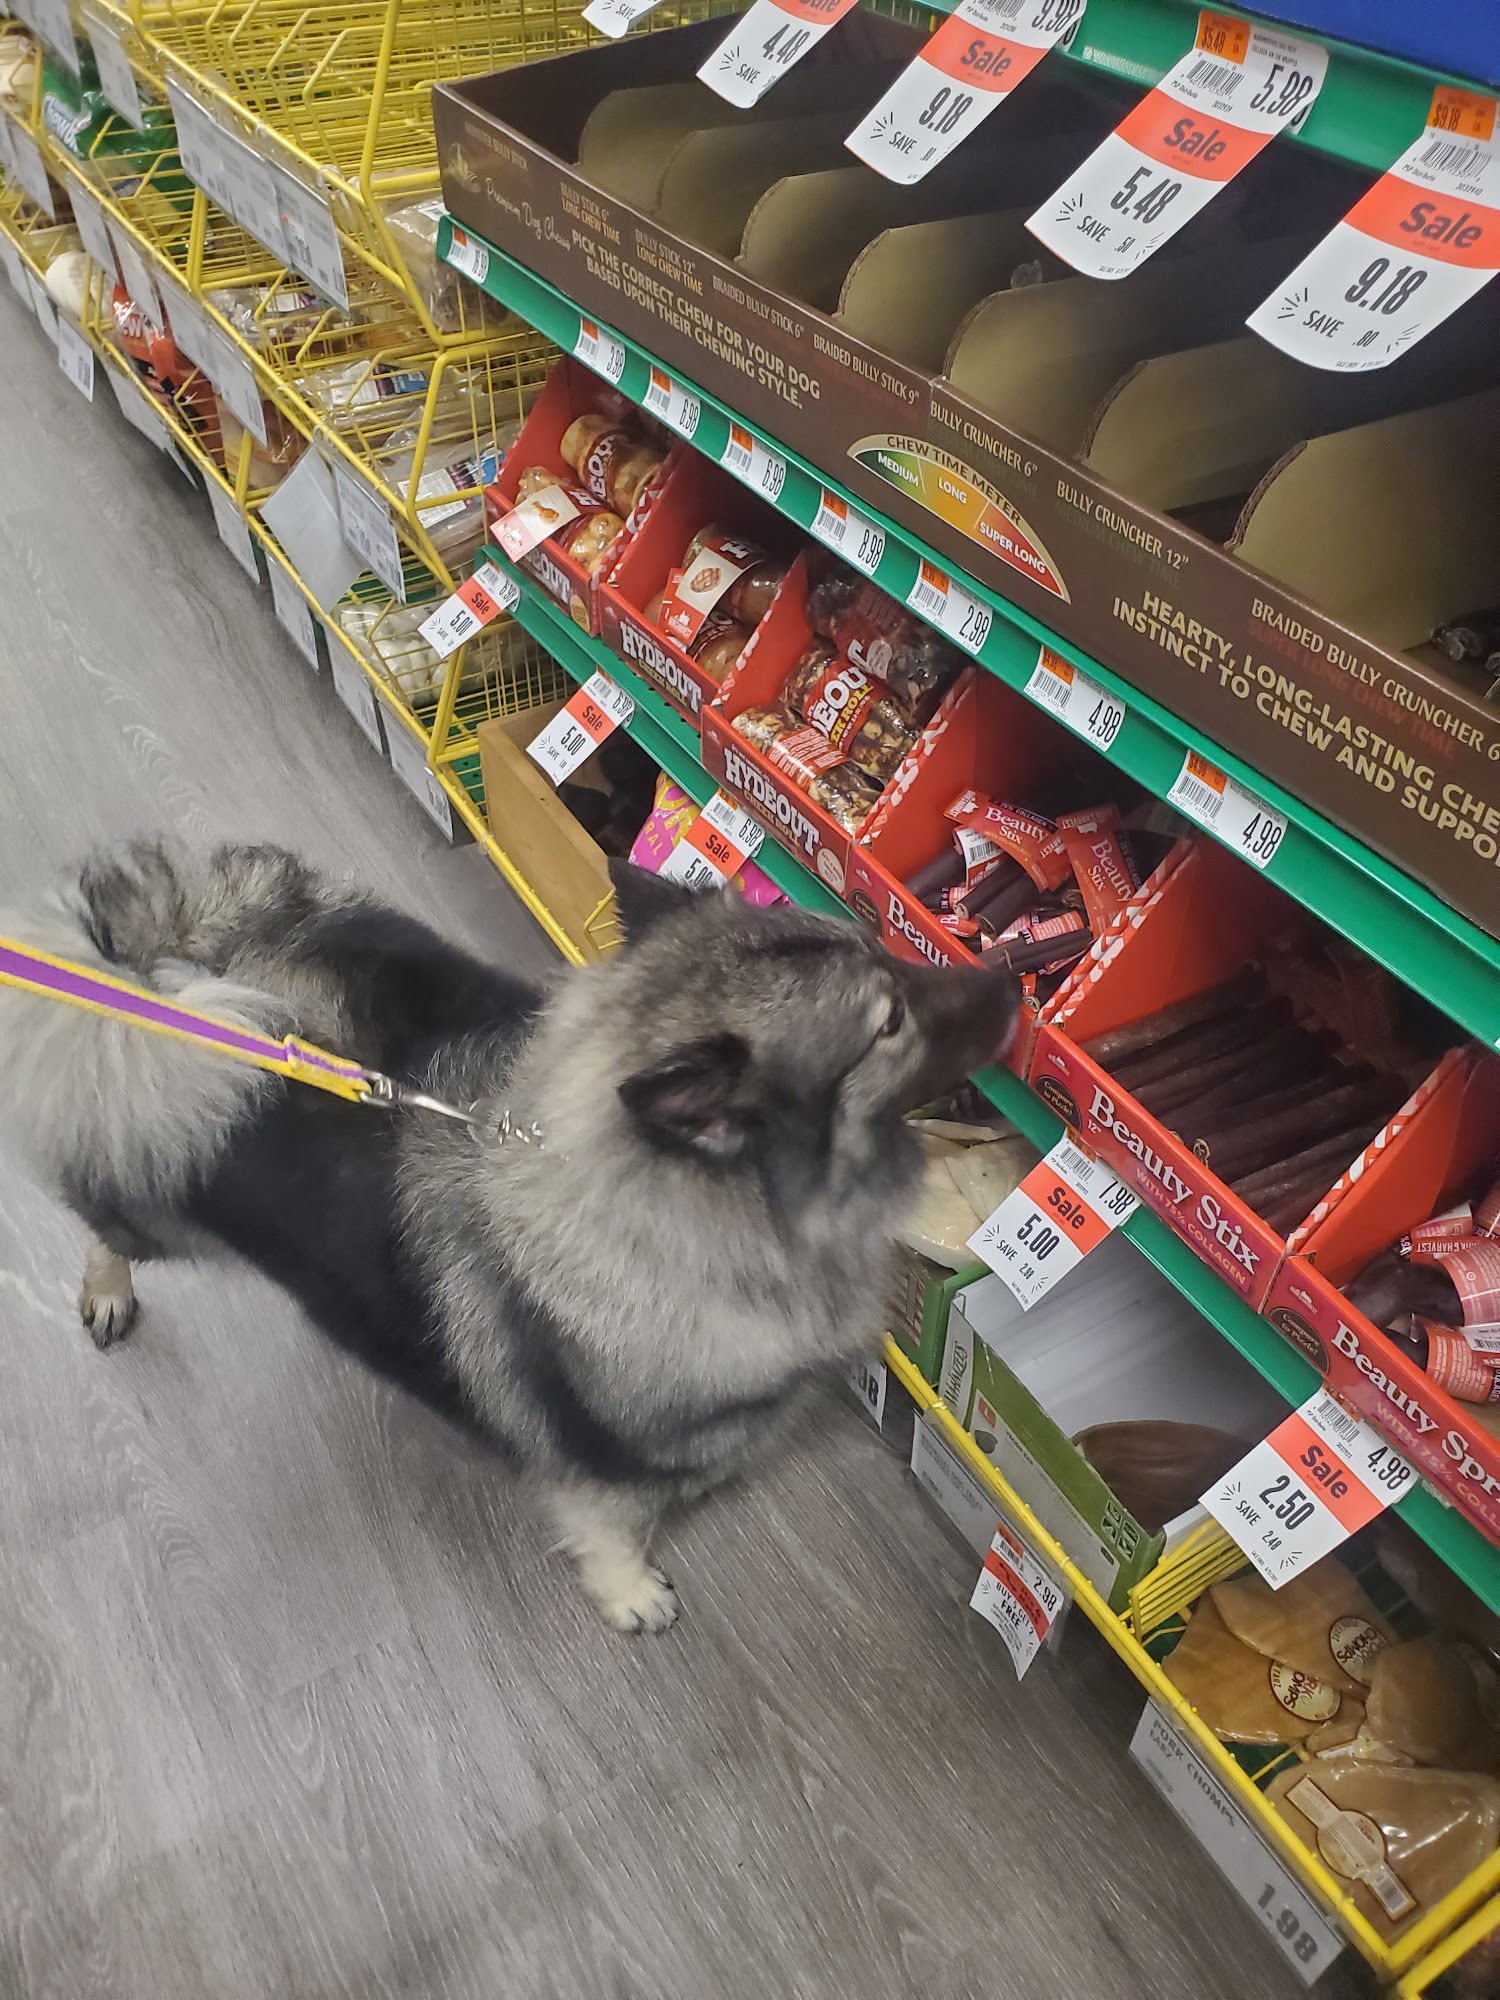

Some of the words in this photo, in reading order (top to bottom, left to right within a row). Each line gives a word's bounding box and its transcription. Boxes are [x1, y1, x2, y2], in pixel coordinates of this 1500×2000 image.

[615, 3, 637, 20] SAVE
[762, 23, 811, 65] 4.48
[960, 39, 1012, 77] Sale
[1202, 25, 1226, 54] $5.48
[735, 63, 761, 85] SAVE
[1249, 63, 1313, 117] 5.98
[918, 86, 974, 134] 9.18
[889, 131, 917, 155] SAVE
[1163, 118, 1226, 162] Sale
[1110, 166, 1183, 224] 5.48
[561, 200, 580, 221] LONG
[580, 211, 601, 233] CHEW
[600, 222, 620, 246] TIME
[1076, 215, 1111, 243] SAVE
[1114, 236, 1136, 253] .50
[1398, 202, 1483, 249] Sale
[636, 244, 657, 268] LONG
[657, 257, 682, 283] CHEW
[682, 272, 704, 296] TIME
[657, 240, 682, 267] STICK
[712, 275, 745, 305] BRAIDED
[745, 294, 770, 319] BULLY
[770, 309, 795, 335] STICK
[1344, 257, 1428, 315] 9.18
[572, 229, 596, 255] PICK
[597, 245, 620, 268] THE
[621, 262, 675, 306] CORRECT
[676, 296, 716, 332] CHEW
[716, 320, 743, 348] FOR
[746, 338, 785, 377] YOUR
[787, 366, 822, 400] DOG
[586, 257, 621, 290] BASED
[623, 281, 656, 313] UPON
[656, 302, 693, 338] THEIR
[695, 328, 756, 378] CHEWING
[757, 367, 804, 410] STYLE.
[1302, 309, 1345, 339] SAVE
[1351, 330, 1380, 348] .80
[606, 345, 624, 378] 3.98
[813, 333, 851, 367] BRAIDED
[852, 355, 880, 383] BULLY
[880, 373, 907, 401] STICK
[679, 398, 699, 433] 6.98
[930, 400, 963, 433] BULLY
[962, 422, 1022, 472] CRUNCHER
[761, 459, 784, 496] 6.98
[877, 451, 920, 487] MEDIUM
[886, 436, 930, 456] CHEW
[932, 450, 969, 479] TIME
[970, 475, 1022, 526] METER
[937, 477, 968, 504] LONG
[1056, 479, 1094, 515] BULLY
[1094, 504, 1163, 558] CRUNCHER
[857, 528, 884, 569] 8.98
[979, 522, 1013, 553] SUPER
[1014, 547, 1047, 575] LONG
[471, 591, 489, 615] Sale
[499, 579, 518, 603] 6.98
[437, 627, 449, 640] SAVE
[449, 609, 474, 637] 5.00
[959, 604, 990, 647] 2.98
[620, 620, 702, 714] HYDEOUT
[1251, 598, 1324, 654] BRAIDED
[1326, 643, 1381, 688] BULLY
[1382, 677, 1485, 753] CRUNCHER
[612, 691, 633, 717] 6.98
[1143, 591, 1235, 669] HEARTY,
[1243, 654, 1436, 792] LONG-LASTING
[582, 705, 603, 732] Sale
[1088, 698, 1122, 744] 4.98
[1113, 597, 1213, 674] INSTINCT
[1218, 664, 1250, 699] TO
[1255, 692, 1334, 752] CHEW
[1335, 745, 1396, 793] AND
[1400, 785, 1500, 868] SUPPO
[546, 746, 561, 761] SAVE
[560, 725, 587, 757] 5.00
[724, 748, 820, 857] HYDEOUT
[738, 818, 762, 847] 6.98
[984, 807, 1049, 843] Beauty
[999, 826, 1024, 845] Stix
[1242, 812, 1282, 860] 4.98
[705, 833, 731, 864] Sale
[1091, 839, 1134, 901] Beauty
[1088, 865, 1106, 891] Stix
[887, 891, 954, 968] Beaut
[1043, 1090, 1053, 1101] to
[1044, 1081, 1074, 1107] Compare
[1088, 1085, 1193, 1204] Beauty
[1047, 1186, 1086, 1230] Sale
[1098, 1176, 1136, 1216] 7.98
[1016, 1213, 1060, 1261] 5.00
[1136, 1168, 1164, 1201] WITH
[1165, 1201, 1186, 1225] 75%
[1188, 1222, 1247, 1285] COLLAGEN
[1197, 1195, 1261, 1275] Stix
[1417, 1241, 1454, 1253] HARVEST
[996, 1239, 1018, 1262] SAVE
[1018, 1262, 1035, 1281] 2.98
[1281, 1323, 1294, 1336] to
[1282, 1313, 1320, 1347] Compare
[1330, 1320, 1440, 1434] Beauty
[1377, 1402, 1419, 1448] WITH
[1420, 1443, 1452, 1482] 75%
[1300, 1445, 1348, 1500] Sale
[1367, 1446, 1411, 1491] 4.98
[1441, 1430, 1500, 1503] Spr
[1258, 1474, 1315, 1531] 2.50
[1235, 1500, 1261, 1526] SAVE
[1262, 1530, 1282, 1551] 2.48
[996, 1581, 1012, 1601] BUY
[1012, 1600, 1018, 1609] 5
[1018, 1608, 1030, 1627] GET
[1028, 1627, 1034, 1638] 2
[1001, 1599, 1022, 1631] FREE
[1033, 1576, 1057, 1612] 2.98
[1336, 1627, 1377, 1664] CHOMPS
[1283, 1671, 1305, 1709] OMPS
[1152, 1719, 1184, 1761] PORK
[1187, 1762, 1236, 1828] CHOMPS
[1257, 1883, 1319, 1966] 1.98
